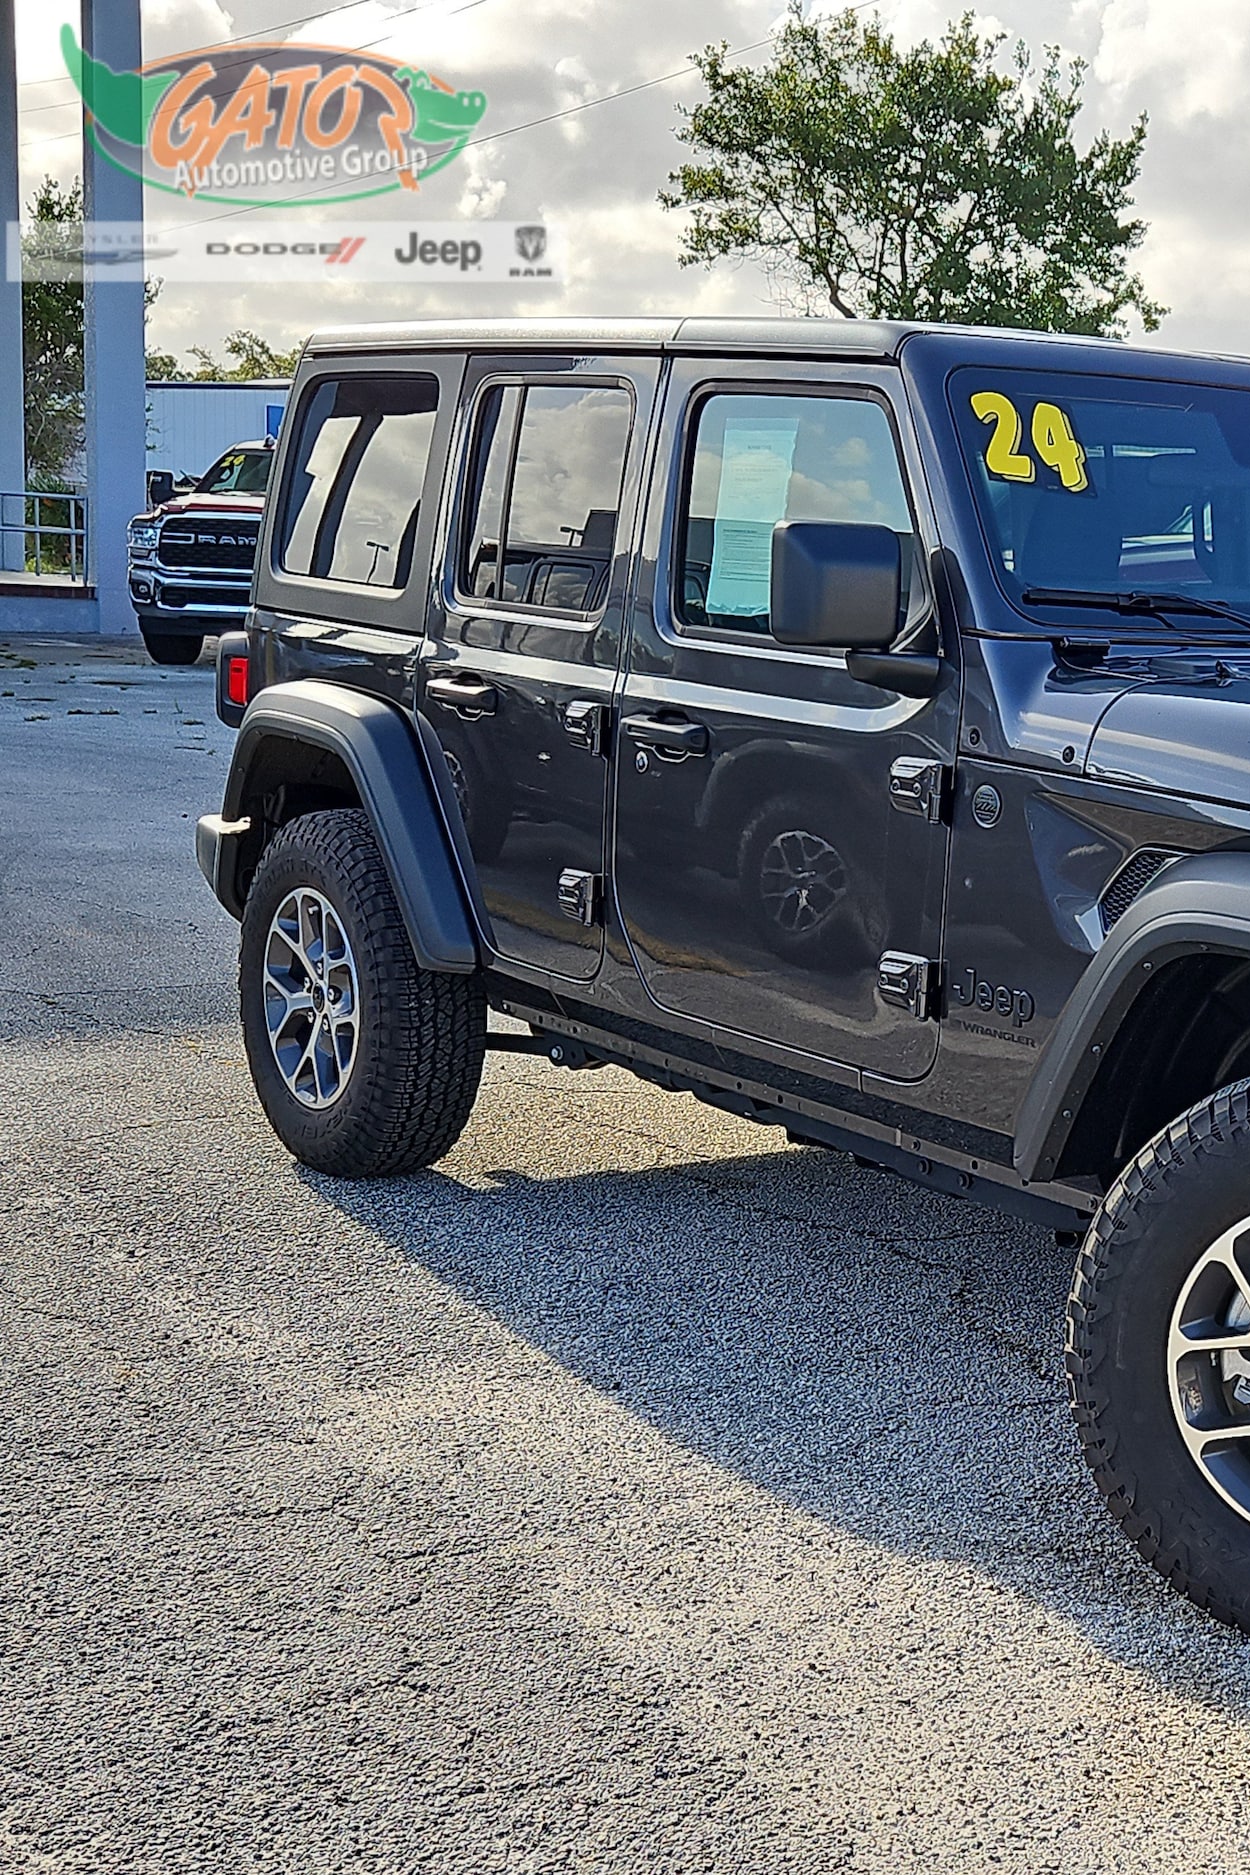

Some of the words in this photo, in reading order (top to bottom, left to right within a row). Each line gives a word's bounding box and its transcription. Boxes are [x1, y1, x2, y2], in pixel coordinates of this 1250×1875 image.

[969, 391, 1089, 493] 24
[198, 534, 257, 546] RAM
[952, 966, 1035, 1029] Jeep
[960, 1020, 1037, 1049] WRANGLER
